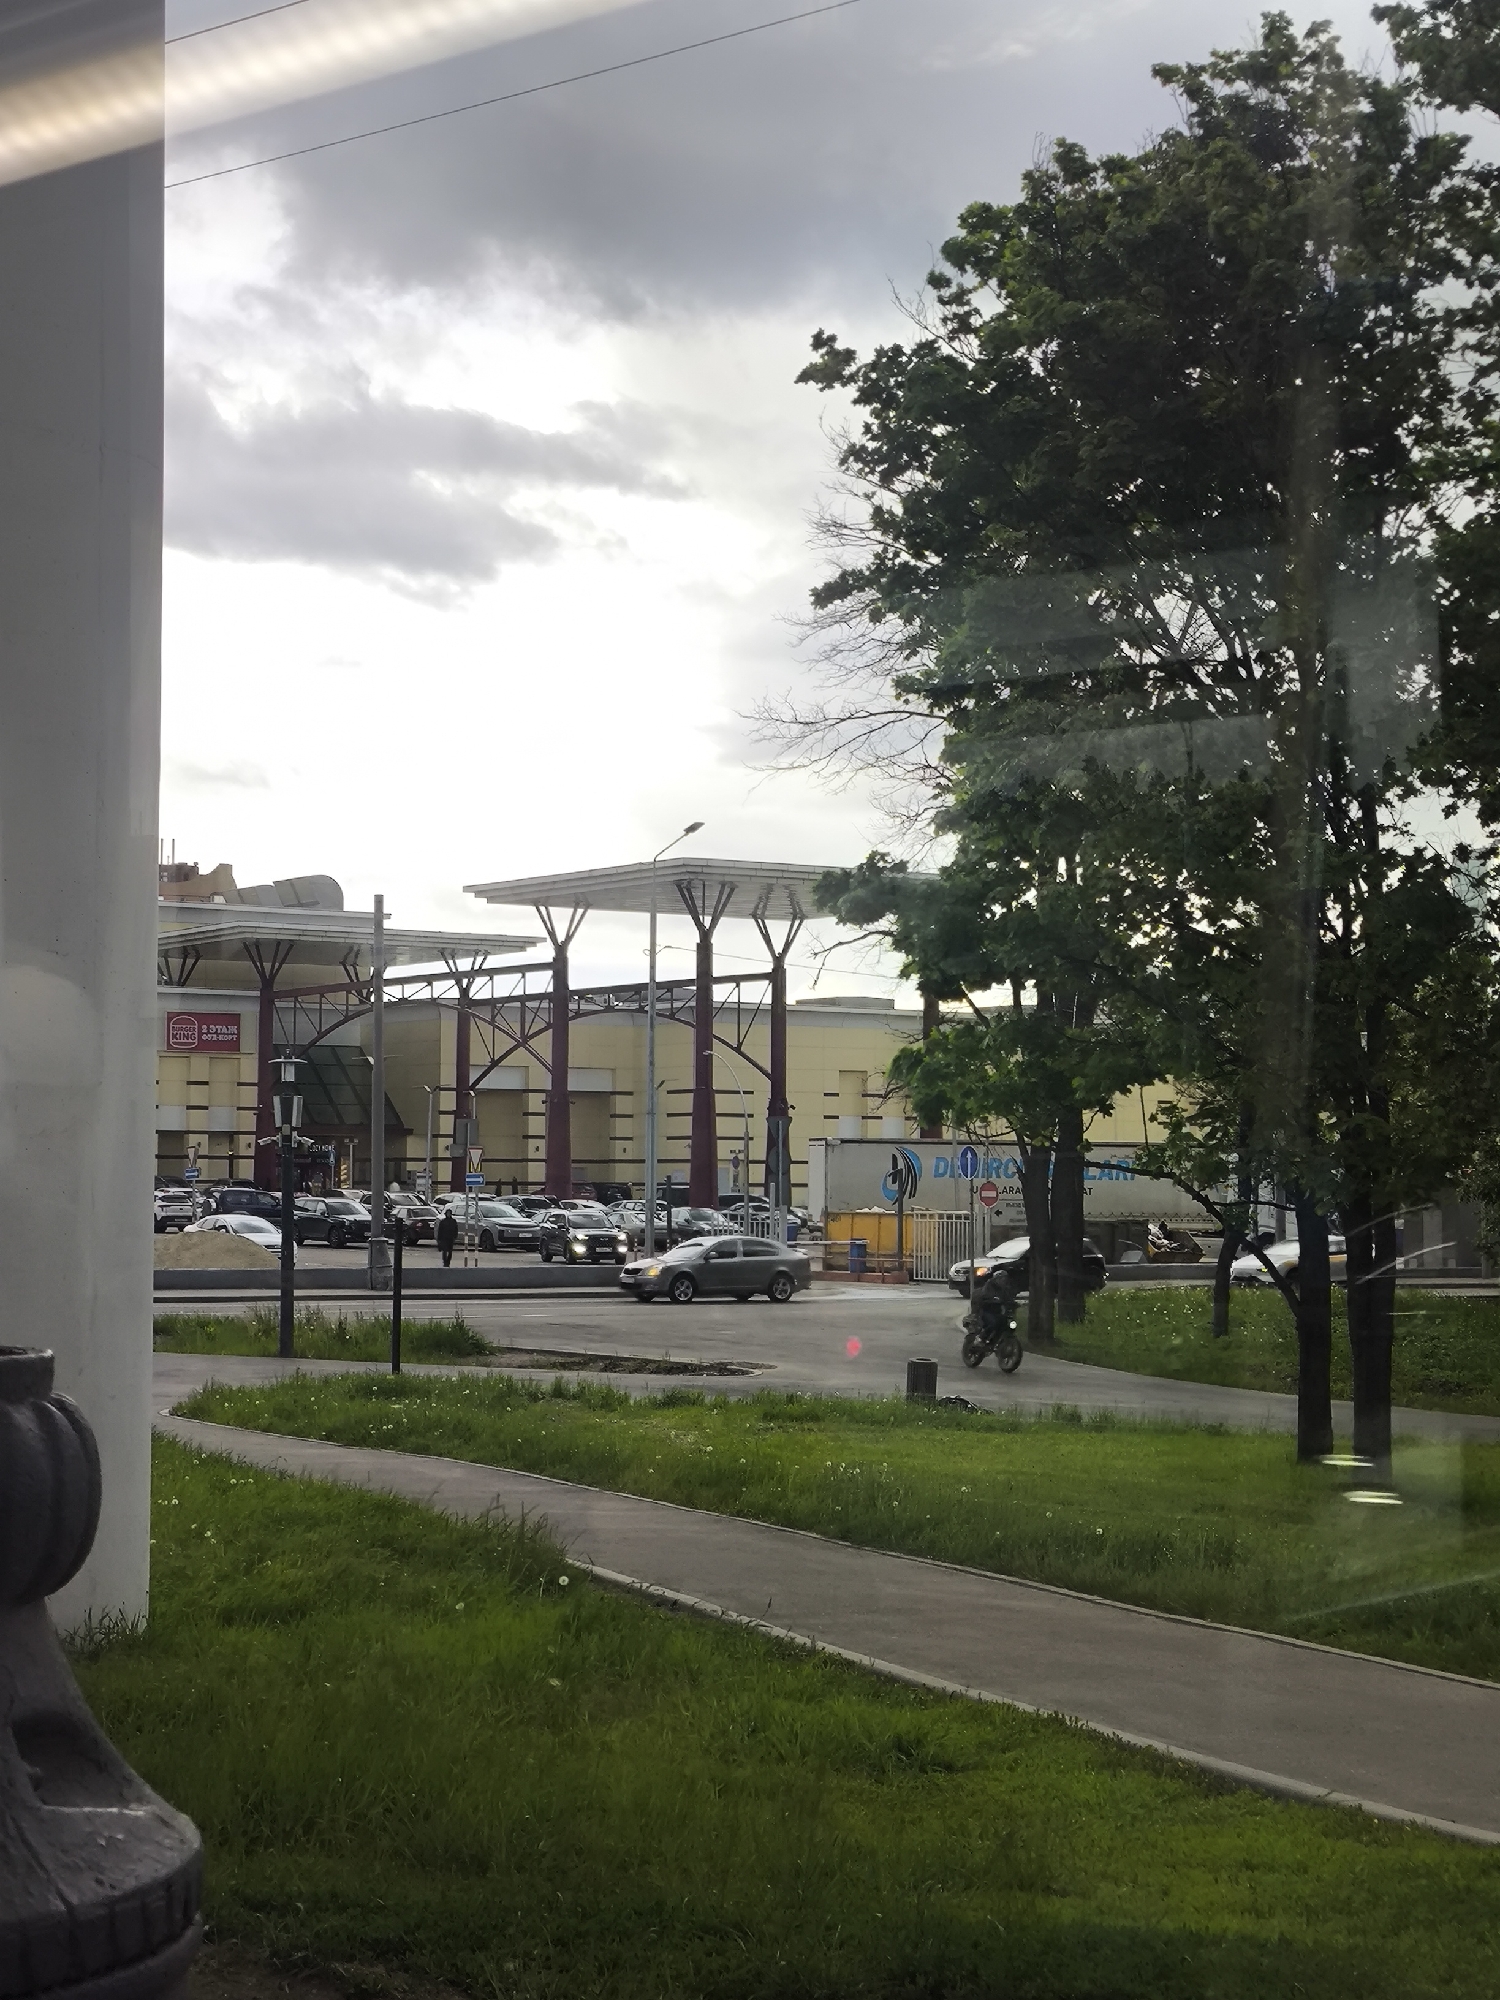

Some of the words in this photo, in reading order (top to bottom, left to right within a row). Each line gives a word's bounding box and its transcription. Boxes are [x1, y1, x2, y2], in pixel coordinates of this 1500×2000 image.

[201, 1024, 208, 1033] 2
[209, 1025, 238, 1034] ЭТАЖ
[171, 1032, 196, 1041] KING
